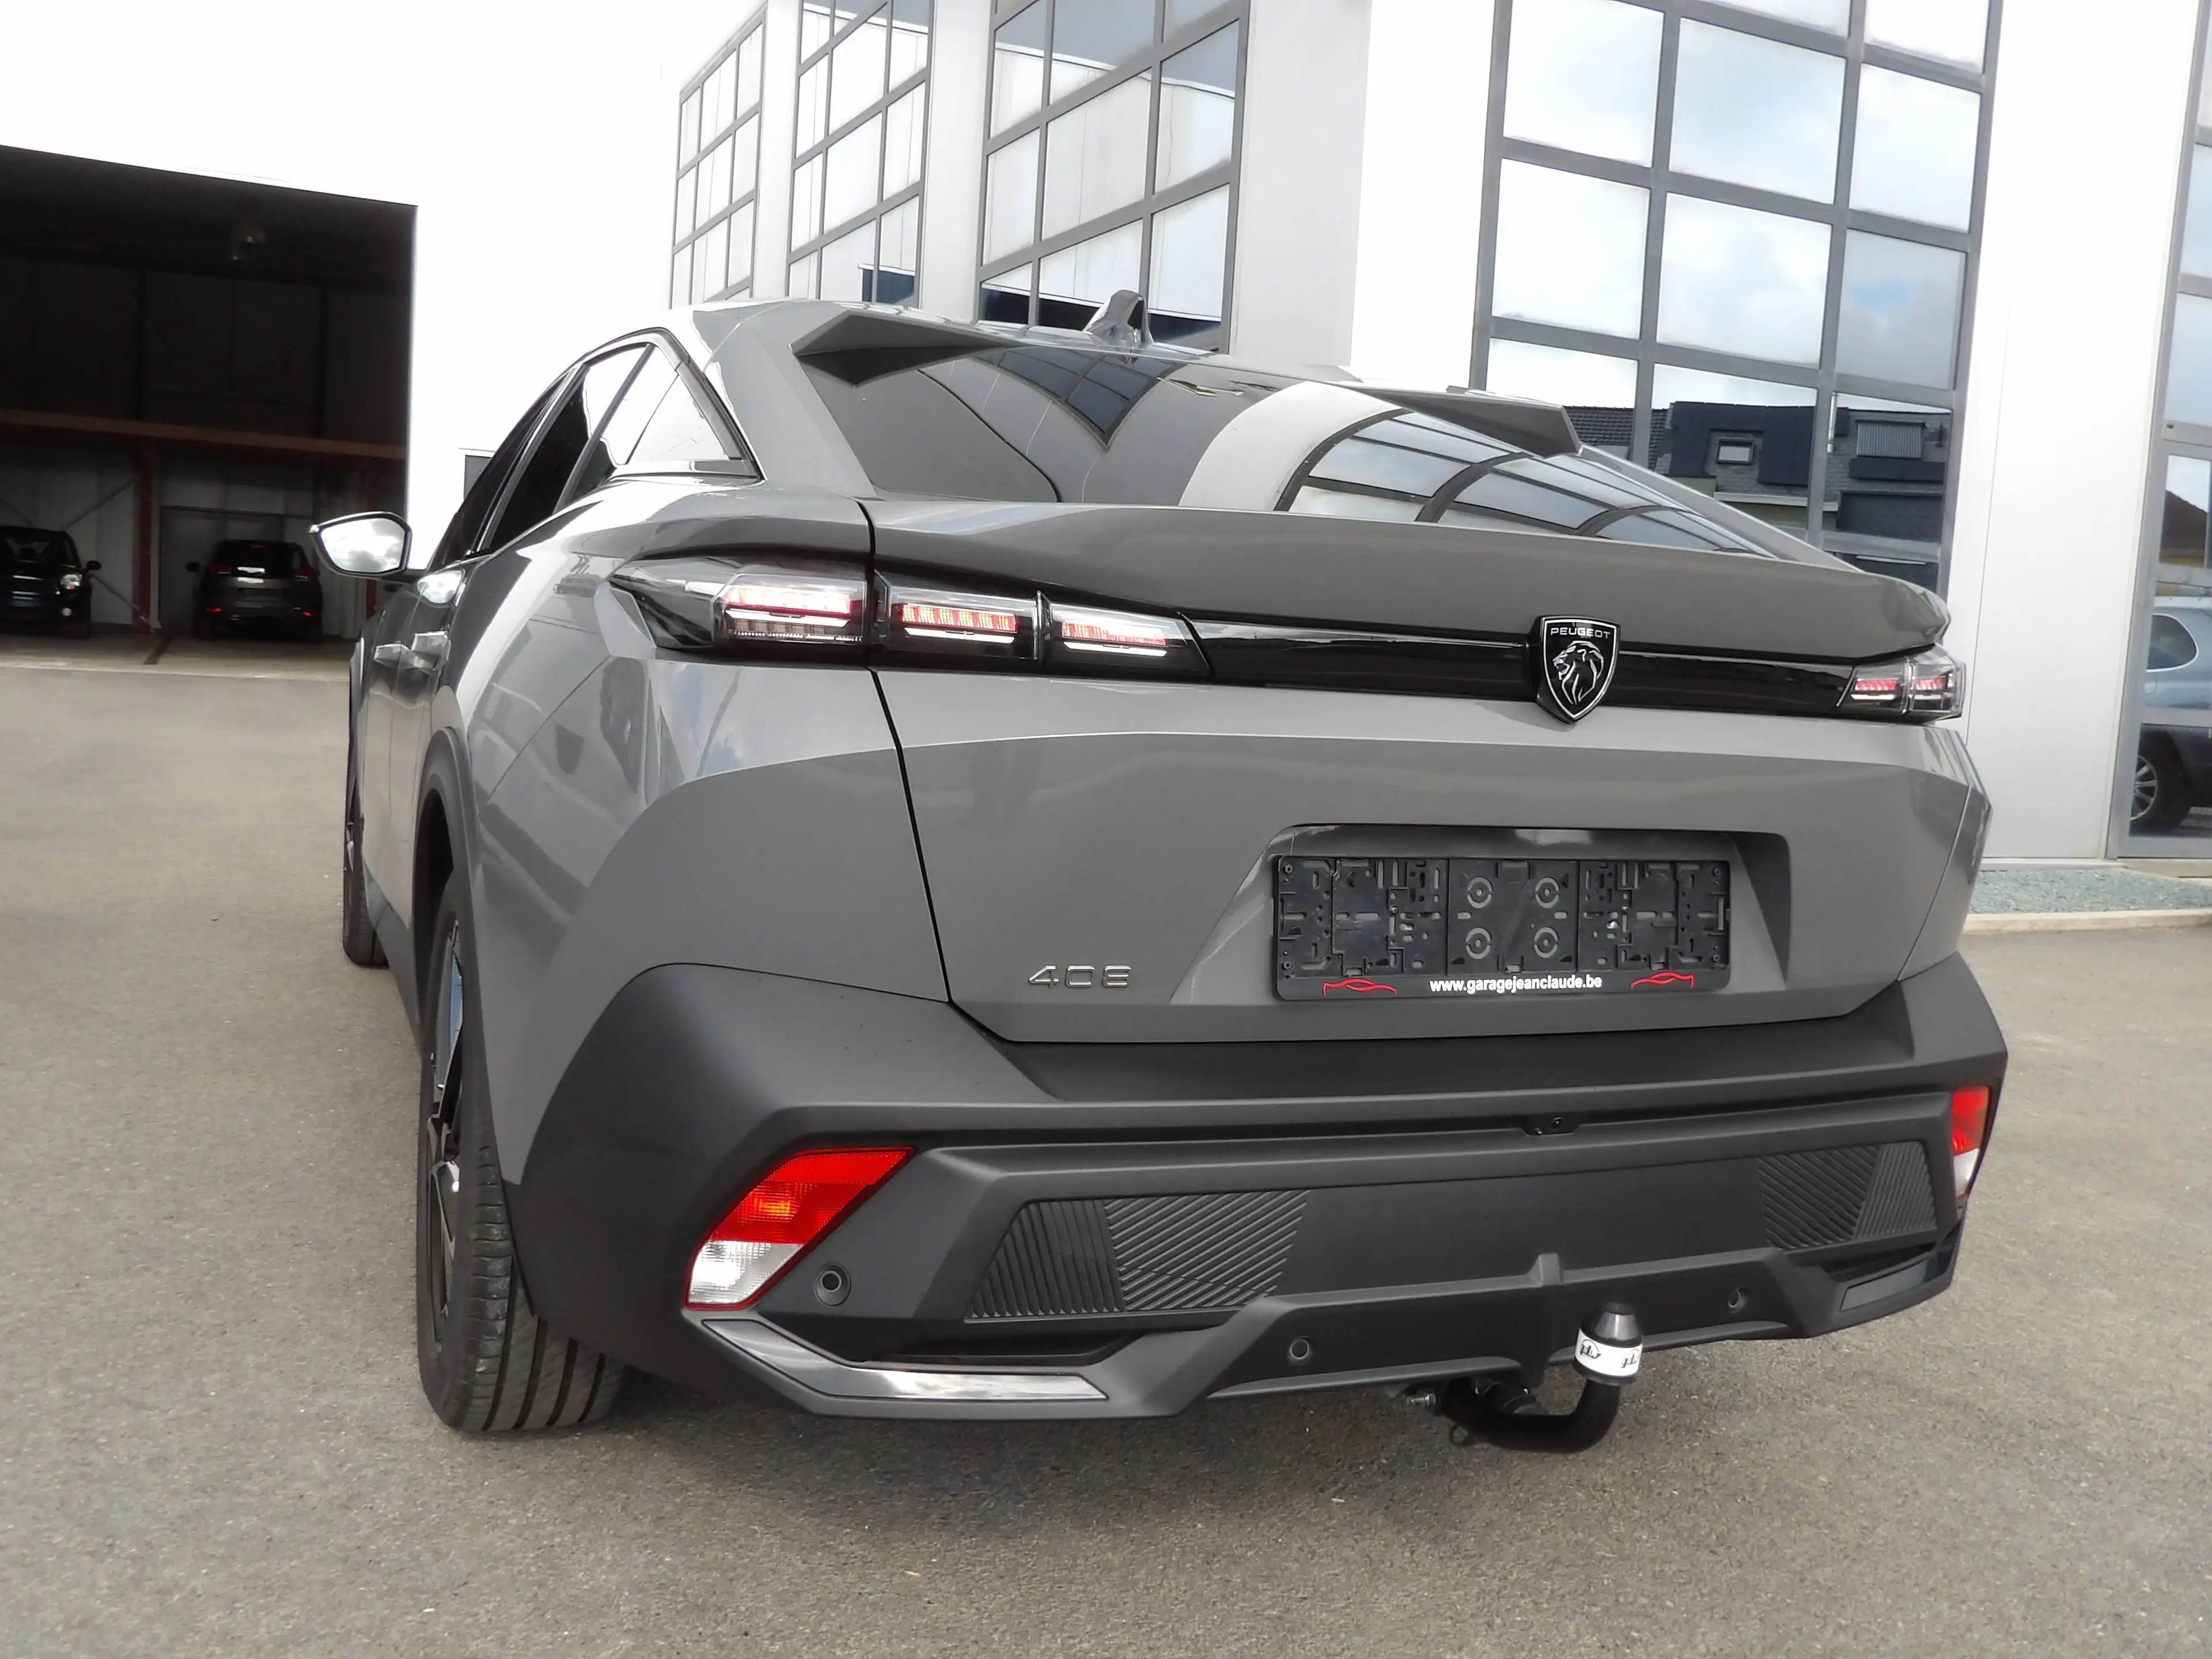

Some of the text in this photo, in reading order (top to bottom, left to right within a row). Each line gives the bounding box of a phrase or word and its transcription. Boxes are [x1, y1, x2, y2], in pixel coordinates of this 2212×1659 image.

[1550, 627, 1611, 639] PEUGEOT
[1028, 964, 1132, 987] 408
[1429, 974, 1603, 994] www.garagejeanclaude.be
